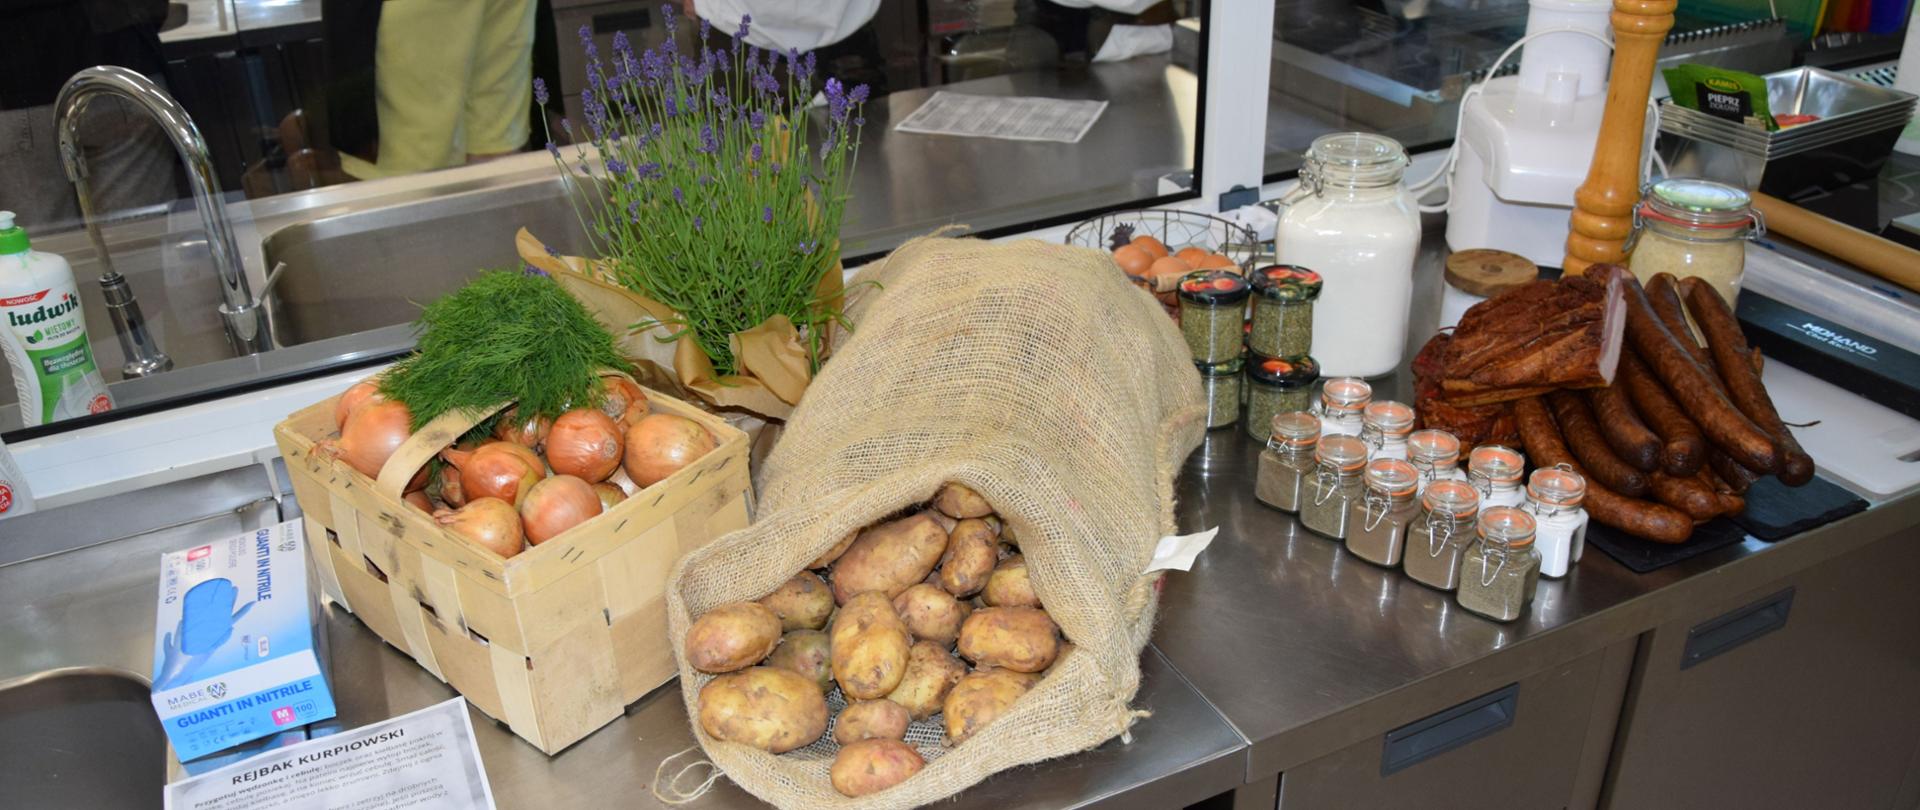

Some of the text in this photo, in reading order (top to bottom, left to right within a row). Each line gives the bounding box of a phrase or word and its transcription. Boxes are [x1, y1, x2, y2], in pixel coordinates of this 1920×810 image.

[1708, 78, 1739, 90] KAMIS
[1707, 92, 1740, 107] PIEPRZ
[8, 292, 79, 327] ludwik
[256, 528, 270, 558] GUANTI
[257, 568, 272, 602] NITRILE
[167, 688, 204, 706] MABE
[177, 704, 235, 729] GUANTI
[238, 700, 253, 711] IN
[256, 679, 313, 706] NITRILE
[295, 702, 313, 713] 100
[276, 708, 290, 720] M
[232, 727, 404, 785] REJBAK KURPIOWSKI
